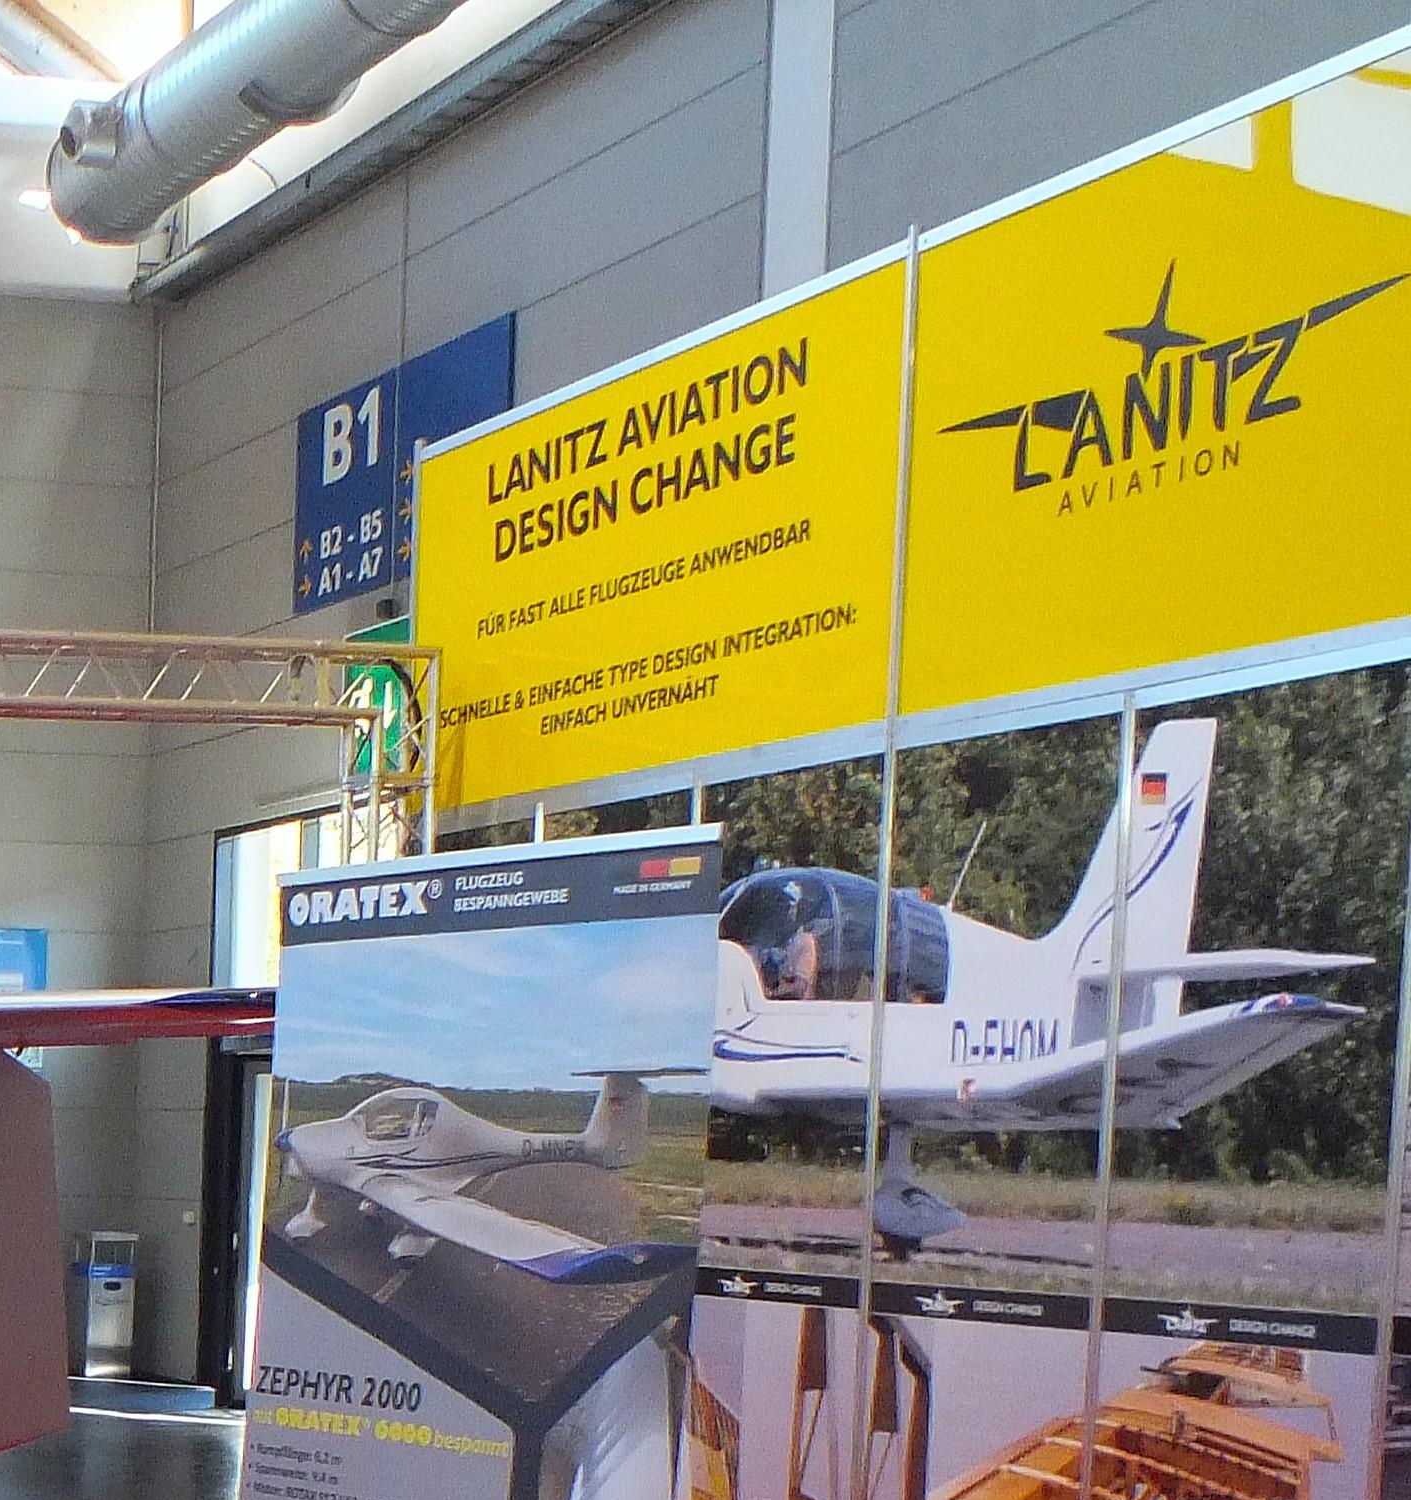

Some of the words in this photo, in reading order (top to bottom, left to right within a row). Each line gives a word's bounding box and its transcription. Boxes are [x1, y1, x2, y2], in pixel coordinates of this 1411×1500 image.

[322, 384, 381, 487] B1
[487, 418, 610, 504] LANITZ
[616, 337, 808, 457] AVIATION
[494, 479, 618, 562] DESIGN
[630, 414, 796, 514] CHANGE
[1057, 440, 1242, 517] AVIATION
[319, 525, 343, 560] B2
[360, 509, 382, 544] B5
[317, 562, 341, 597] A1
[357, 547, 383, 581] A7
[476, 611, 505, 640] FÜR
[509, 600, 545, 631] FAST
[548, 589, 585, 618] ALLE
[589, 559, 685, 608] FLUGZEUGE
[689, 519, 811, 576] ANWENDBAR
[441, 692, 511, 730] SCHNELLE
[515, 690, 524, 709] &
[529, 668, 603, 707] EINFACHE
[608, 657, 648, 687] TYPE
[653, 641, 717, 676] DESIGN
[723, 602, 858, 658] INTEGRATION:
[540, 707, 607, 737] EINFACH
[611, 674, 719, 719] UNVERNÄHT
[453, 888, 570, 914] BESPANNGEWEBE
[455, 871, 525, 892] FLUGZEUG
[254, 1364, 354, 1404] ZEPHYR
[360, 1376, 422, 1413] 2000
